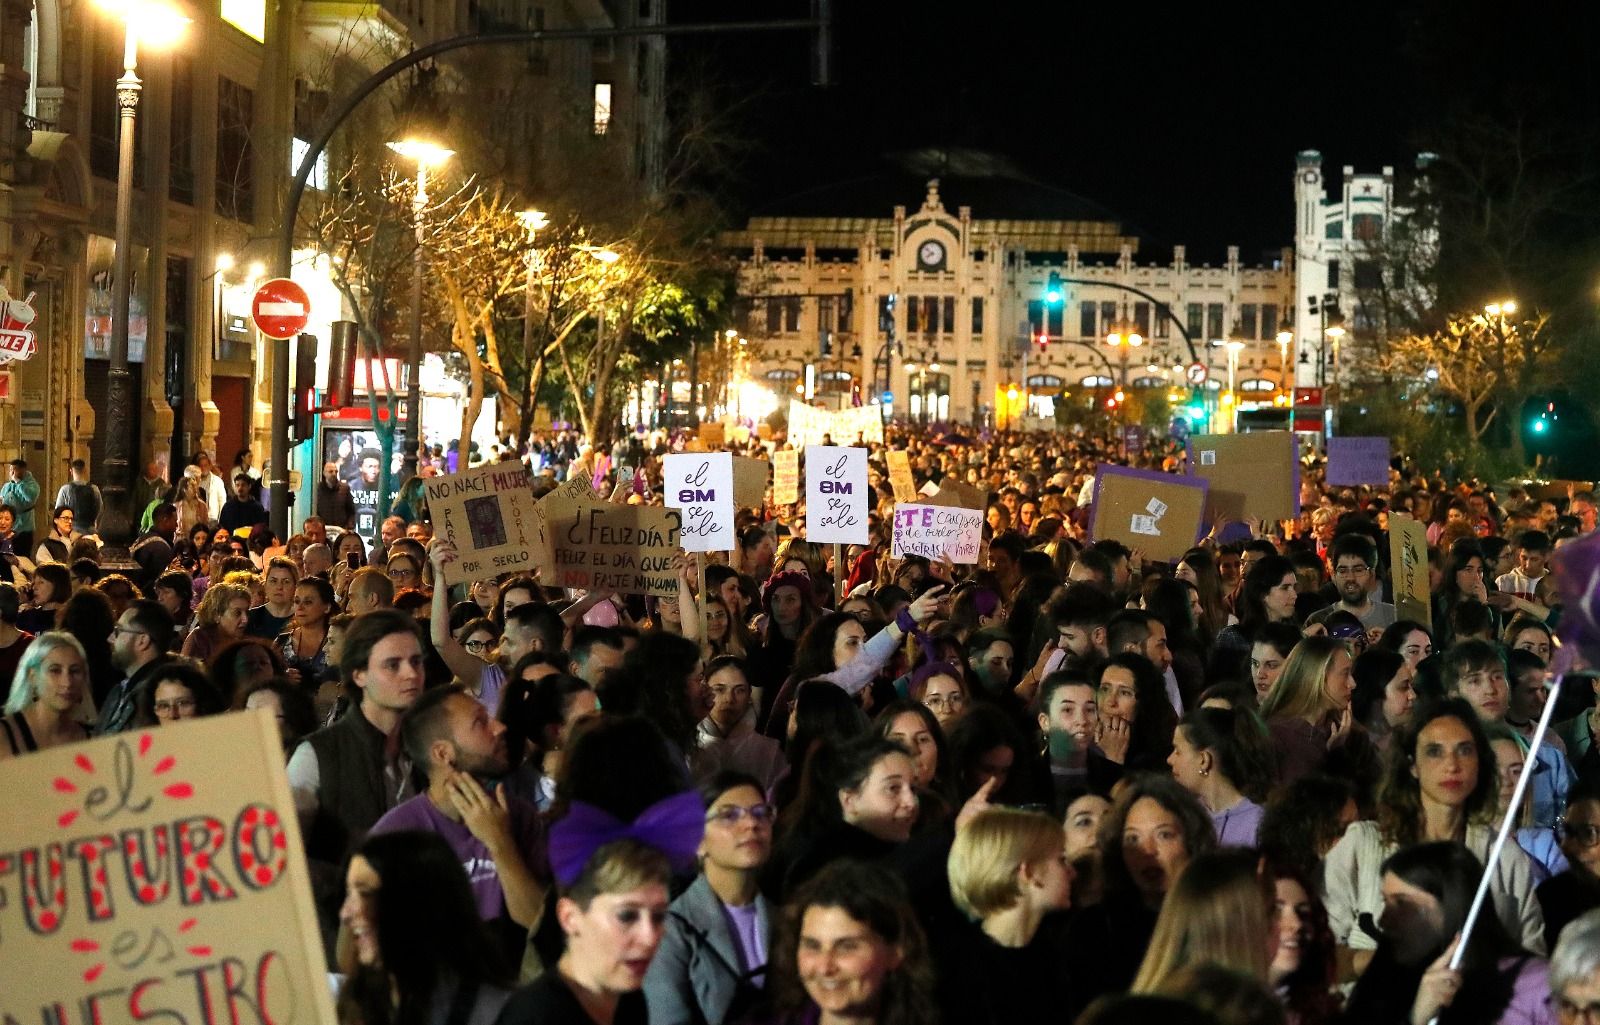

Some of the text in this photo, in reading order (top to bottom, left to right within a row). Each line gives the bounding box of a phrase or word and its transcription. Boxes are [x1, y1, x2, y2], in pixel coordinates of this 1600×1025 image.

[685, 461, 709, 487] el
[825, 454, 848, 479] el
[428, 482, 450, 500] NO
[492, 469, 531, 492] MUJER
[678, 489, 715, 503] 8M
[819, 480, 853, 495] 8M
[688, 506, 708, 519] se
[820, 504, 859, 528] sale
[828, 498, 846, 510] se
[444, 508, 458, 551] PARA
[680, 511, 723, 537] sale
[463, 551, 529, 572] POR SERLO
[555, 549, 671, 572] FELIZ EL DÍA QUE
[593, 572, 630, 588] FALTE
[85, 738, 153, 821] el
[111, 927, 175, 970] es
